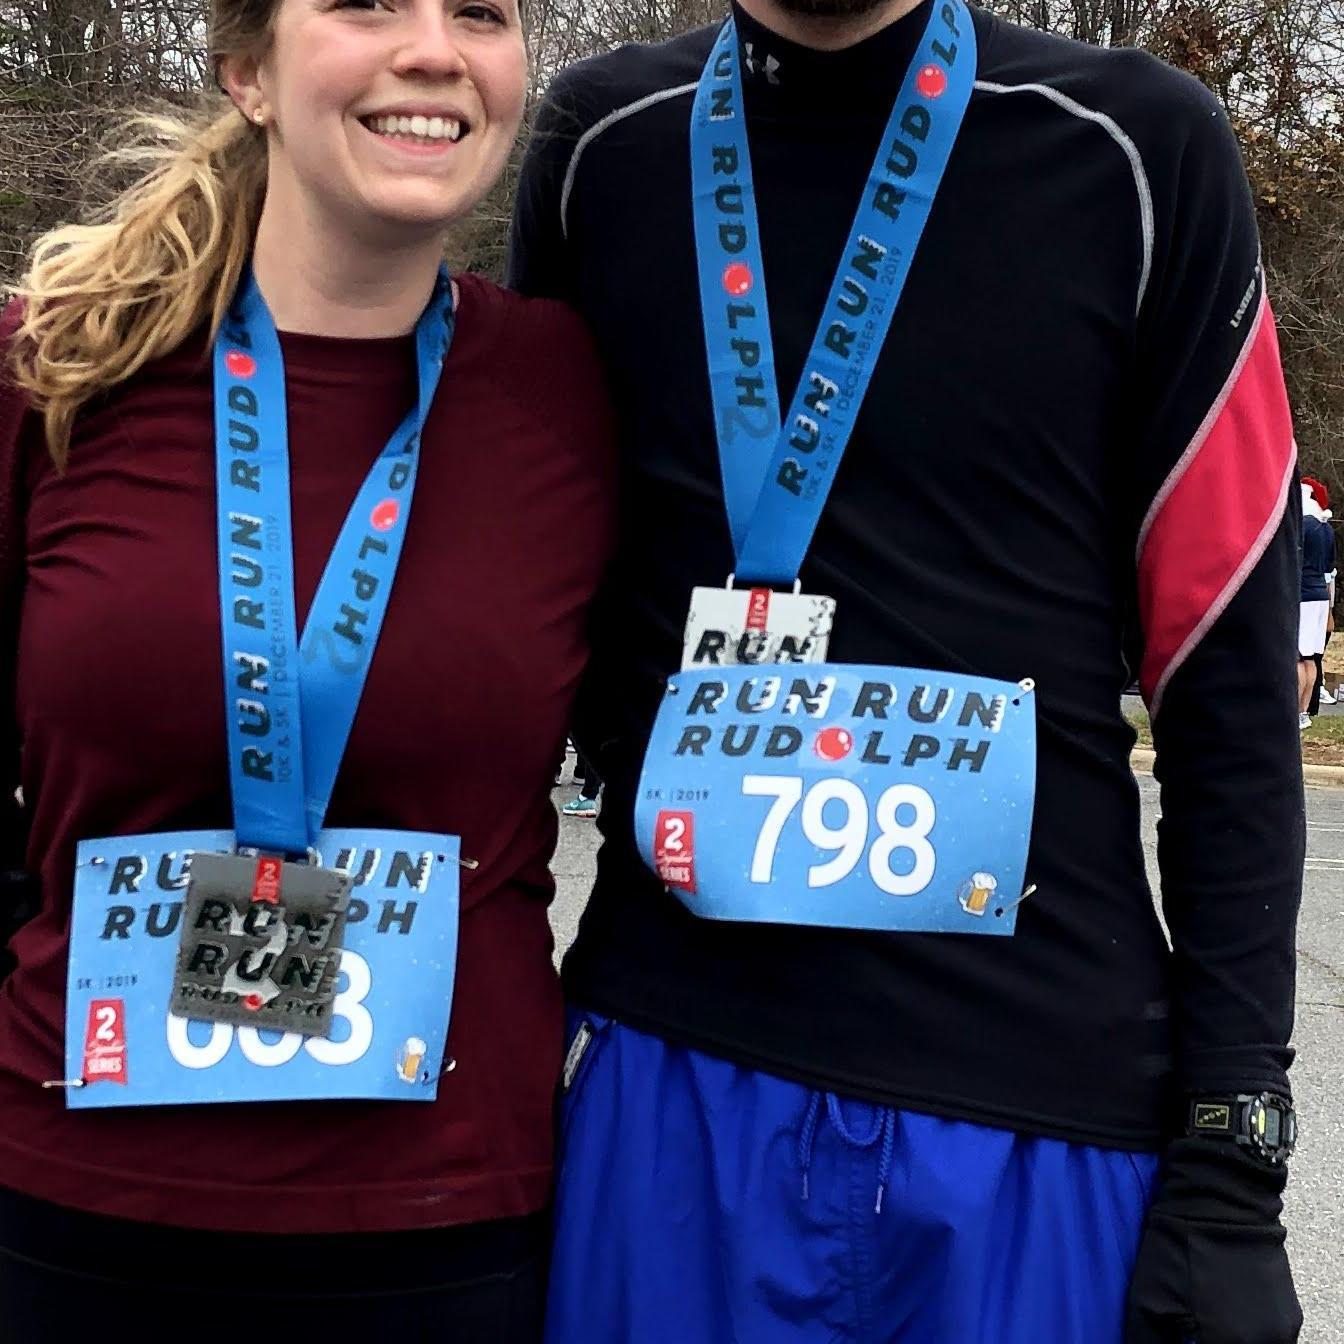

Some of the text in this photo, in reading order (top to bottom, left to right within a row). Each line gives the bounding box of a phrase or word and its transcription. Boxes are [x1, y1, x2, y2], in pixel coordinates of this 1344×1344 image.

[825, 234, 887, 360] RUN
[228, 512, 265, 632] RUN
[686, 676, 1007, 733] RUN RUN
[741, 774, 937, 896] 798
[187, 941, 329, 994] RUN
[96, 1006, 117, 1042] 2
